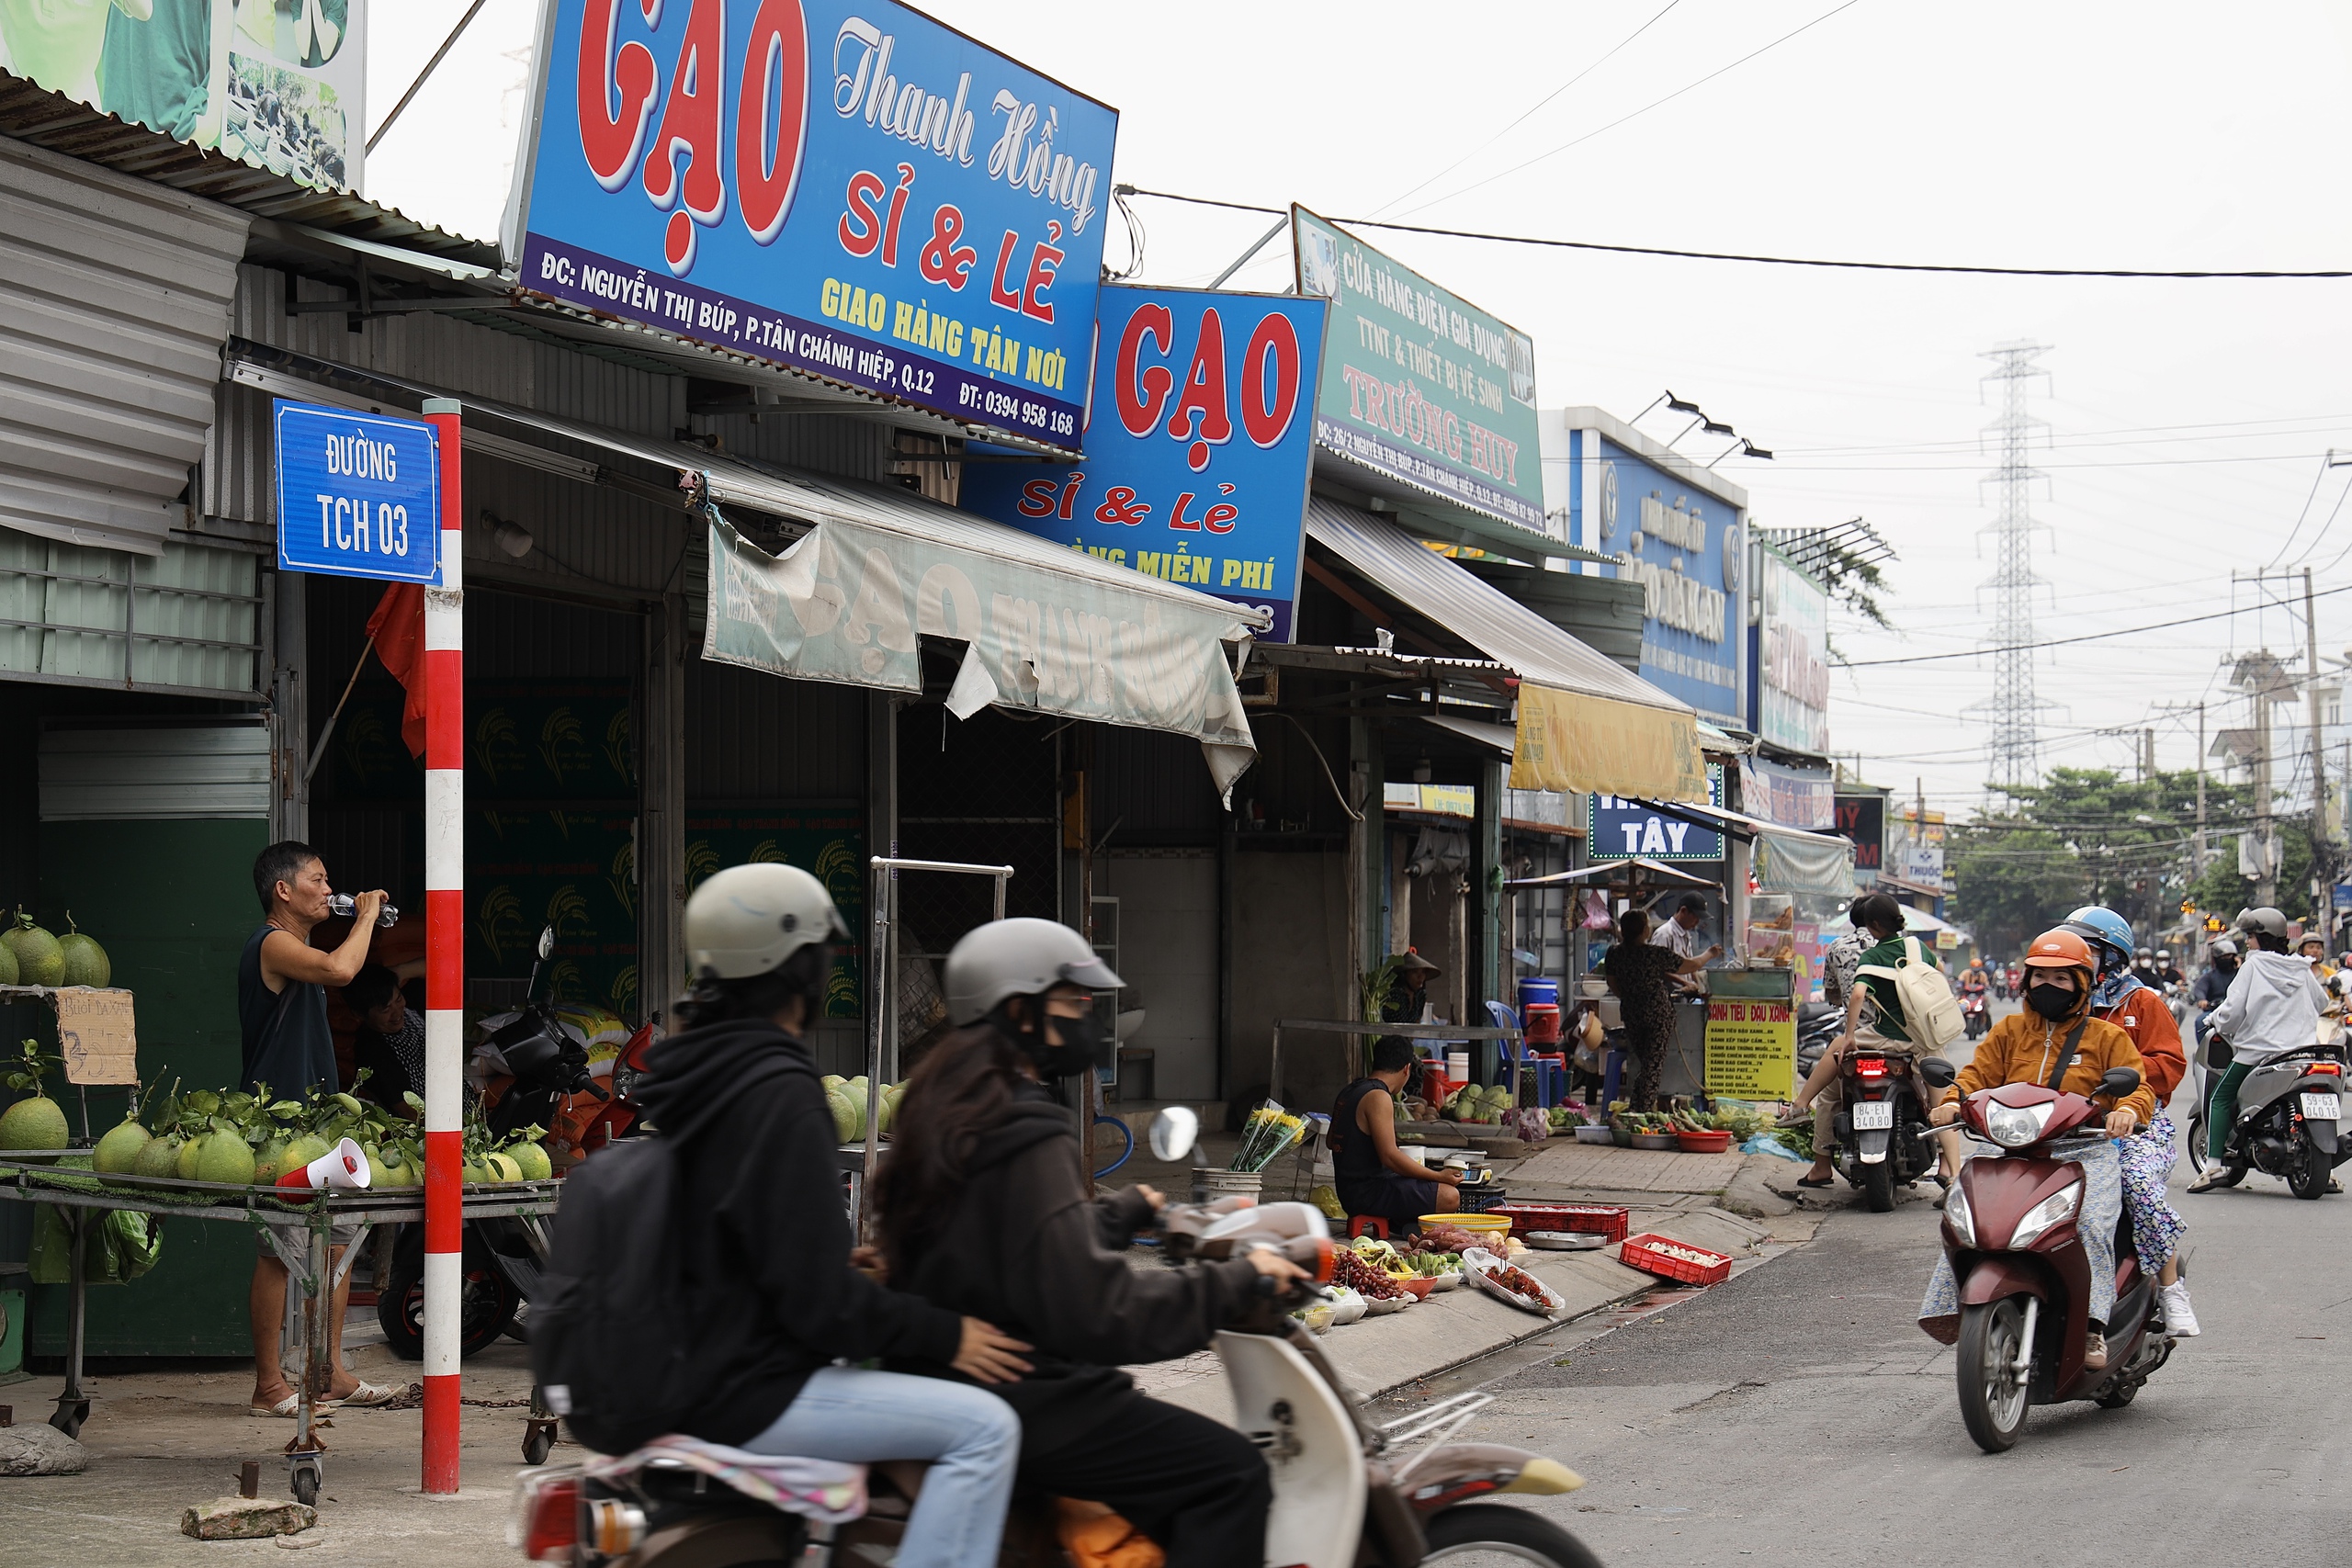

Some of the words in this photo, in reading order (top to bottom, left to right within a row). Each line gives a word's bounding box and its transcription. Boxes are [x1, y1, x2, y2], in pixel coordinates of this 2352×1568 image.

[577, 0, 810, 277] GẠO
[832, 16, 974, 169] Thanh
[987, 89, 1097, 236] Hồng
[838, 163, 915, 269] SỈ
[920, 203, 977, 292] &
[990, 220, 1065, 324] LẺ
[820, 277, 887, 331] GIAO
[893, 294, 963, 359] HÀNG
[970, 323, 1020, 379] TẬN
[1025, 343, 1067, 391] NƠI
[1343, 243, 1374, 300] CỬA
[1375, 265, 1416, 322] HÀNG
[1416, 290, 1450, 340] ĐIỆN
[1451, 310, 1473, 352] GIA
[1473, 322, 1508, 371] DỤNG
[541, 253, 575, 288] ĐC:
[580, 266, 659, 313] NGUYỄN
[663, 288, 695, 330] THỊ
[698, 299, 741, 344] BÚP,
[745, 317, 796, 354] P.TÂN
[798, 331, 854, 371] CHÁNH
[857, 351, 898, 392] HIỆP,
[900, 368, 935, 396] Q.12
[959, 381, 981, 409] ĐT:
[985, 390, 1019, 422] 0394
[1022, 400, 1047, 429] 958
[1049, 409, 1073, 436] 168
[1357, 315, 1390, 359] TTNT
[1395, 334, 1406, 367] &
[1406, 340, 1442, 384] THIẾT
[1445, 359, 1460, 400] BỊ
[1460, 363, 1476, 406] VỆ
[1477, 376, 1505, 415] SINH
[1115, 302, 1301, 473] GẠO
[325, 428, 397, 482] ĐƯỜNG
[1317, 420, 1333, 440] ĐC:
[1333, 427, 1353, 449] 26/2
[1354, 434, 1384, 462] NGUYỄN
[1385, 445, 1398, 470] THỊ
[1416, 460, 1436, 481] P.TÂN
[1436, 467, 1458, 491] CHÁNH
[1343, 364, 1463, 463] TRƯỜNG
[1467, 420, 1518, 488] HUY
[316, 494, 370, 553] TCH
[378, 502, 409, 557] 03
[1017, 471, 1086, 521] SỈ
[1094, 486, 1152, 526] &
[1136, 541, 1213, 584] MIỄN
[1221, 557, 1274, 591] PHÍ
[1621, 817, 1690, 854] TÂY
[1909, 864, 1942, 877] THUỐC
[1796, 929, 1815, 944] BÉ
[1750, 1000, 1767, 1026] ĐẬU
[1769, 1004, 1790, 1023] XANH
[1856, 1115, 1889, 1128] 340.80
[1859, 1104, 1884, 1116] 84-E1
[2306, 1095, 2334, 1107] 59-G3
[2306, 1107, 2338, 1118] 040.16
